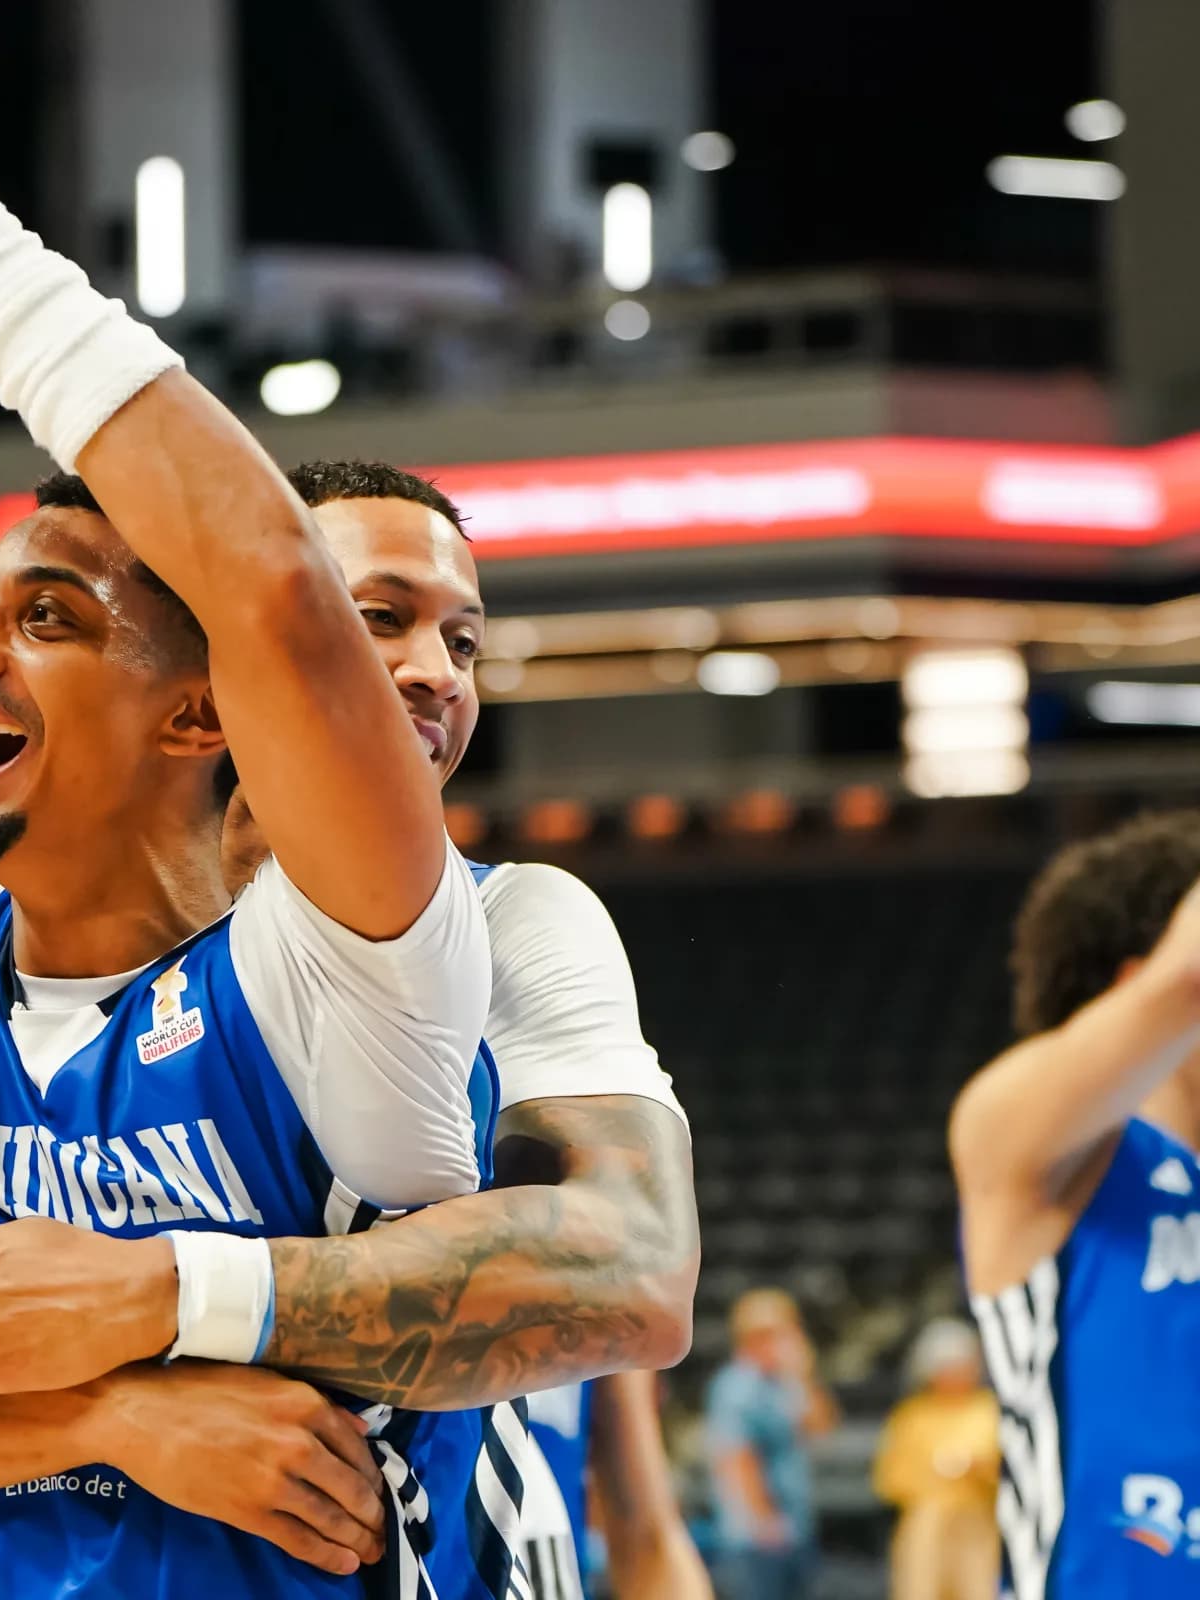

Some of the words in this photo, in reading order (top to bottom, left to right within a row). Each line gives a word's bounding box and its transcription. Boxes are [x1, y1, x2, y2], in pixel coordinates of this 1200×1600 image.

[142, 1027, 178, 1049] WORLD
[179, 1016, 199, 1031] CUP
[143, 1024, 201, 1061] QUALIFIERS
[85, 1474, 113, 1497] de
